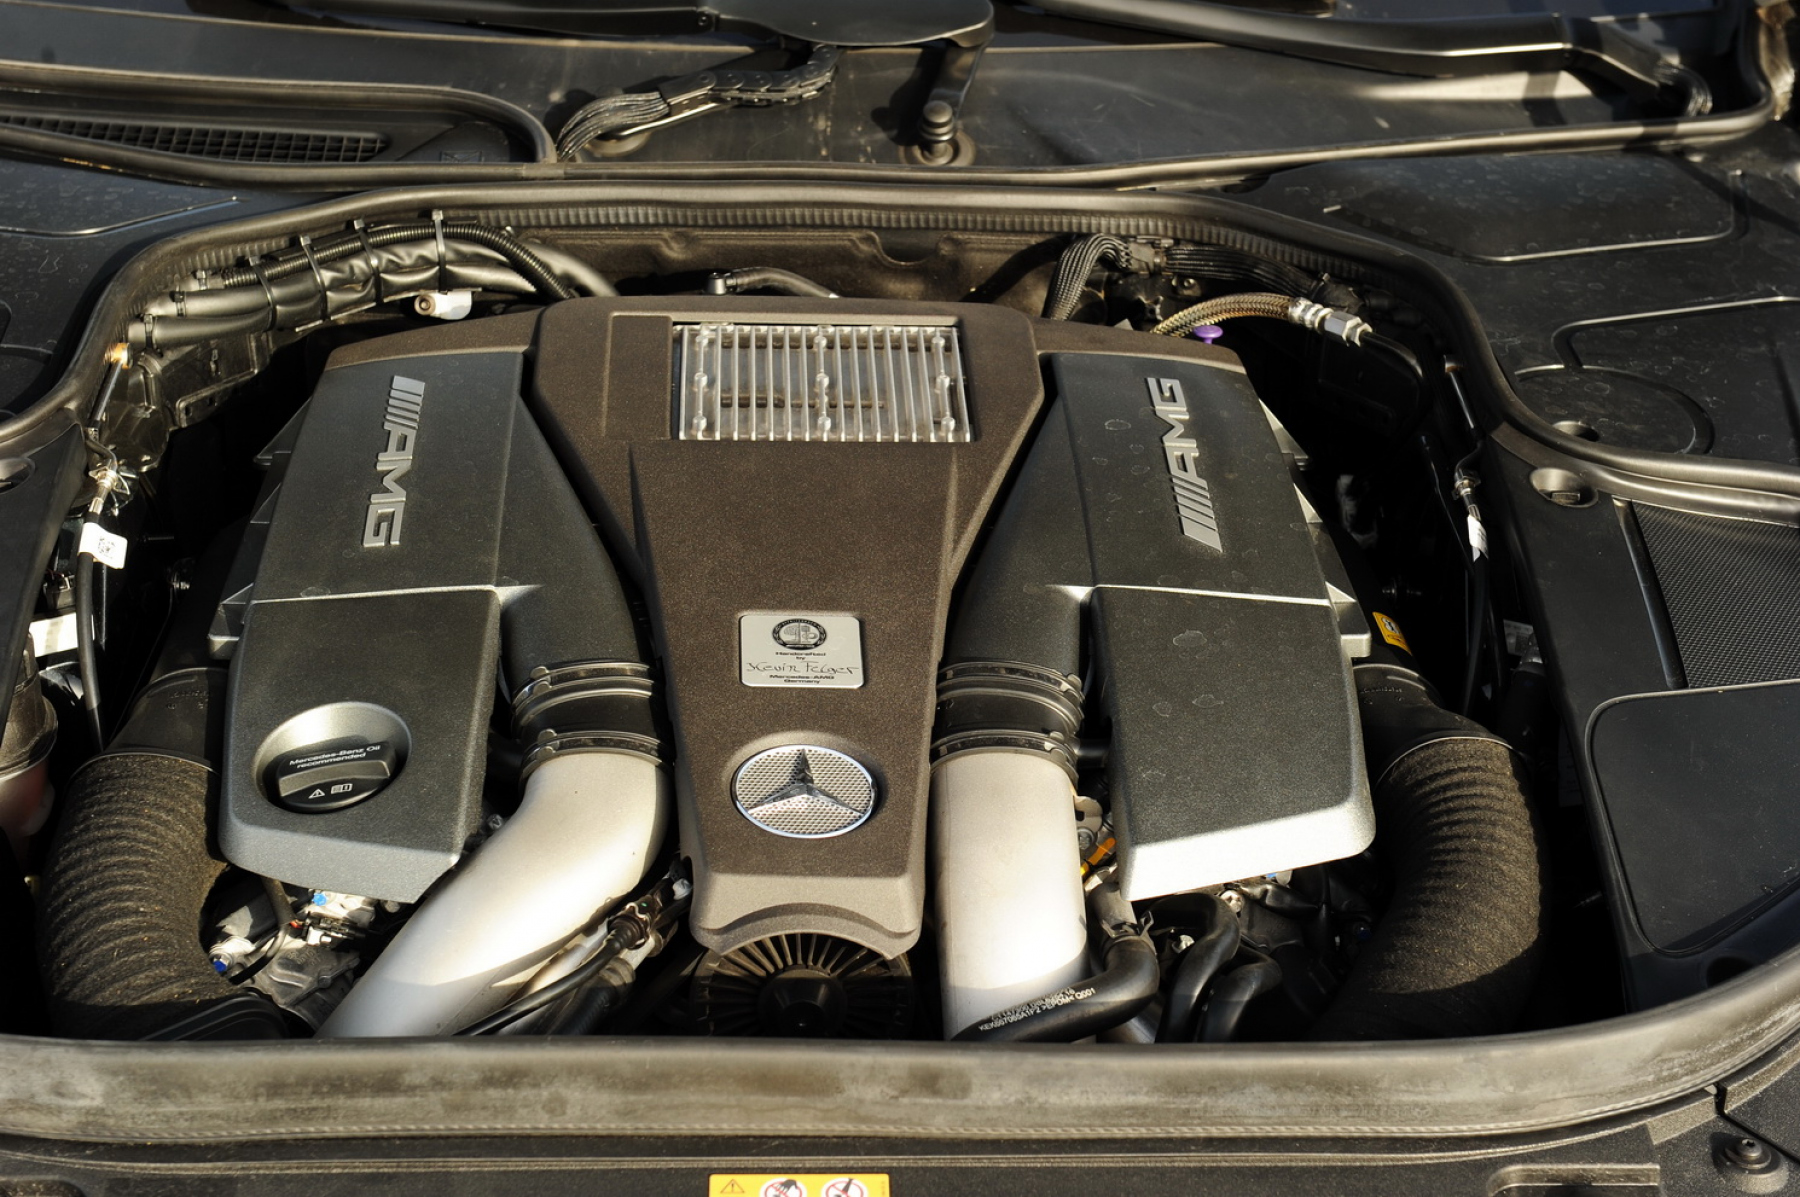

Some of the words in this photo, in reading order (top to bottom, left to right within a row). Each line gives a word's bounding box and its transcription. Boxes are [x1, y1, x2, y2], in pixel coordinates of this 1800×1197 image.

[362, 420, 418, 548] AMG
[289, 747, 365, 766] Mercedes-Benz
[366, 744, 382, 752] Oil
[296, 752, 367, 769] recommended
